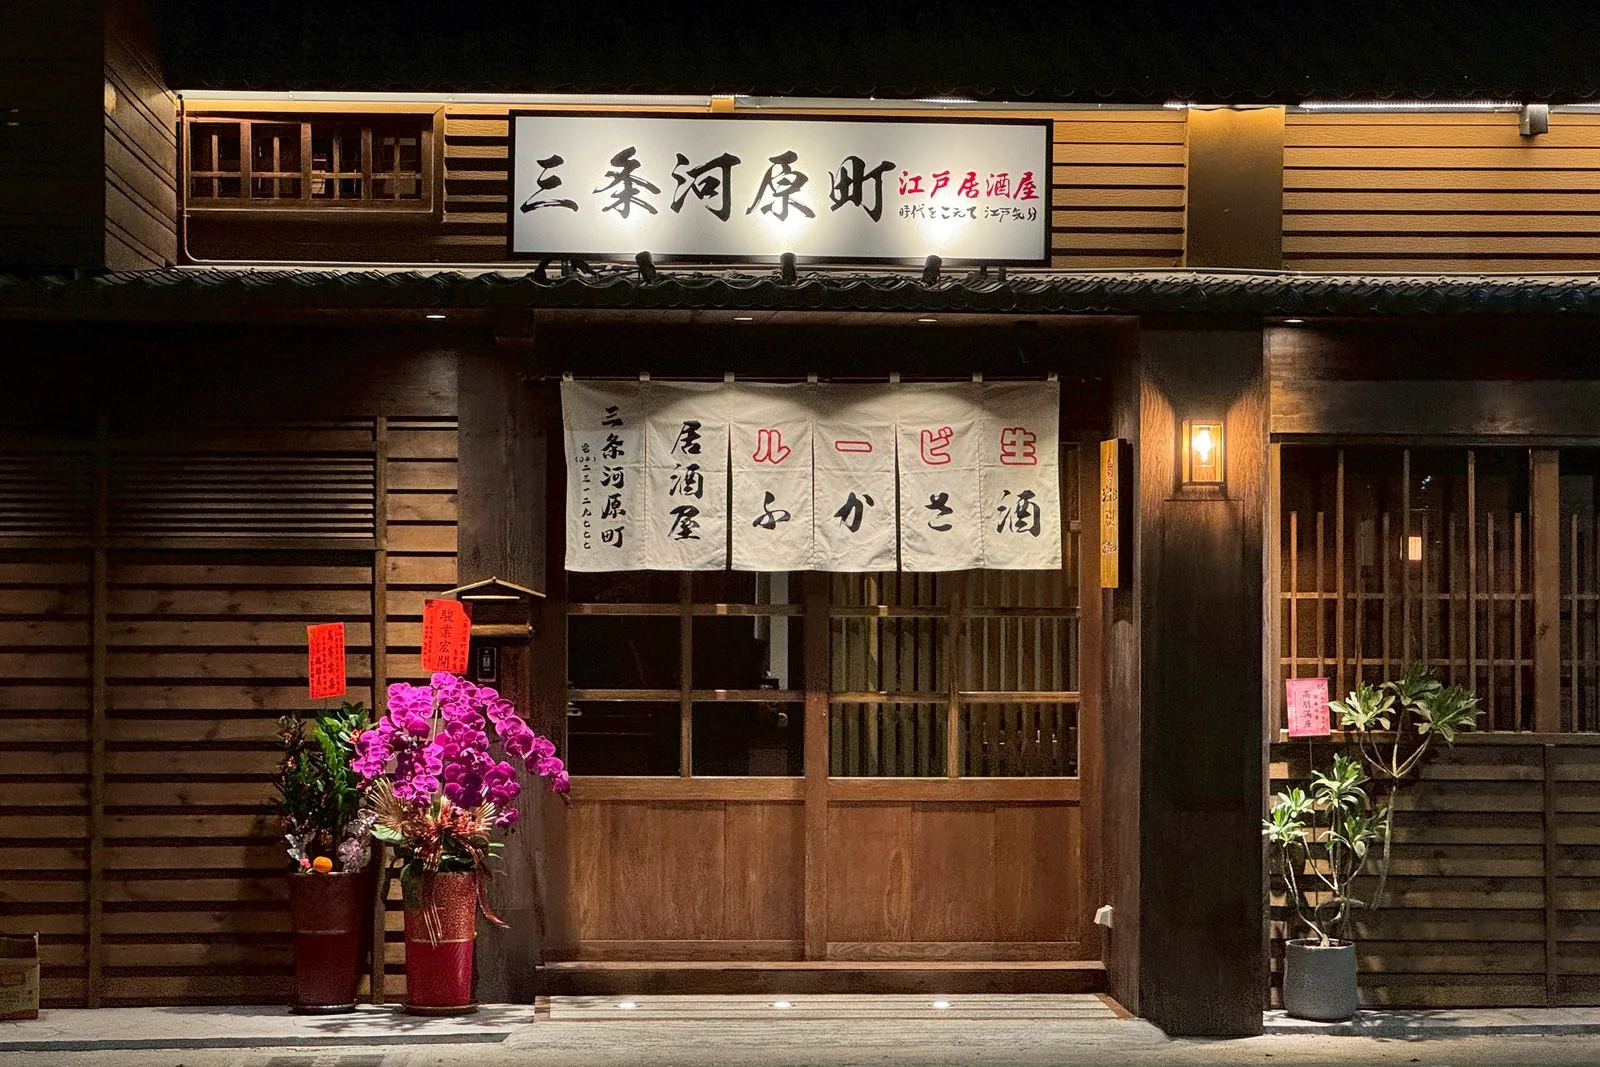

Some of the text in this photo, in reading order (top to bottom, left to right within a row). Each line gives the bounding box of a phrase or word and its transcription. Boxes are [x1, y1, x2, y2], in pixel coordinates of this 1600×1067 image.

[519, 145, 897, 223] 三条河原町
[600, 405, 627, 549] 三条河原町
[667, 420, 704, 541] 居酒屋
[437, 608, 455, 670] 駿業宏開
